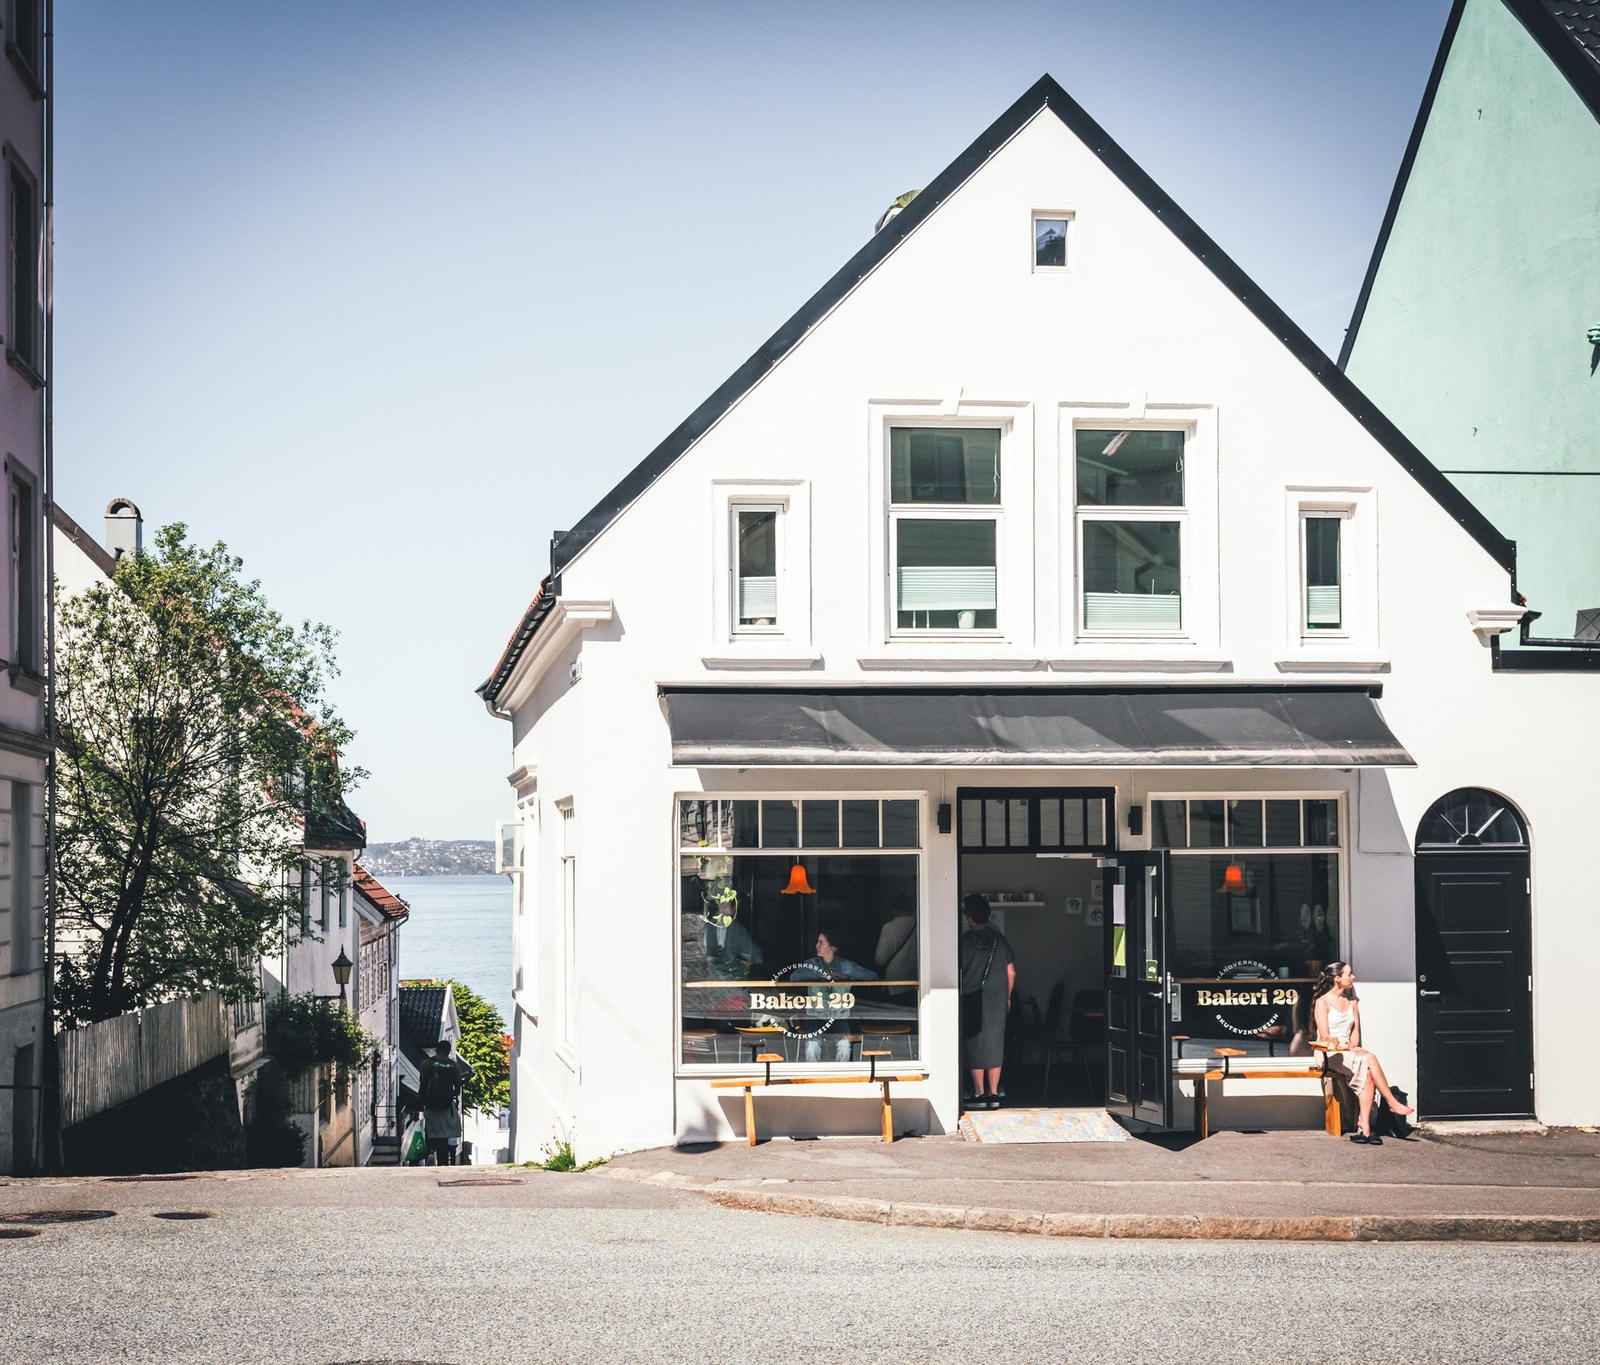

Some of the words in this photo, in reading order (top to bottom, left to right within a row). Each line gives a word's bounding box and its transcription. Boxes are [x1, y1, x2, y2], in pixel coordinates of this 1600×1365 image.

[749, 991, 825, 1010] Bakeri
[828, 992, 856, 1009] 29
[1196, 988, 1269, 1006] Bakeri
[1273, 988, 1300, 1006] 29
[1215, 1013, 1280, 1035] SKUTEVIKSVEIEN
